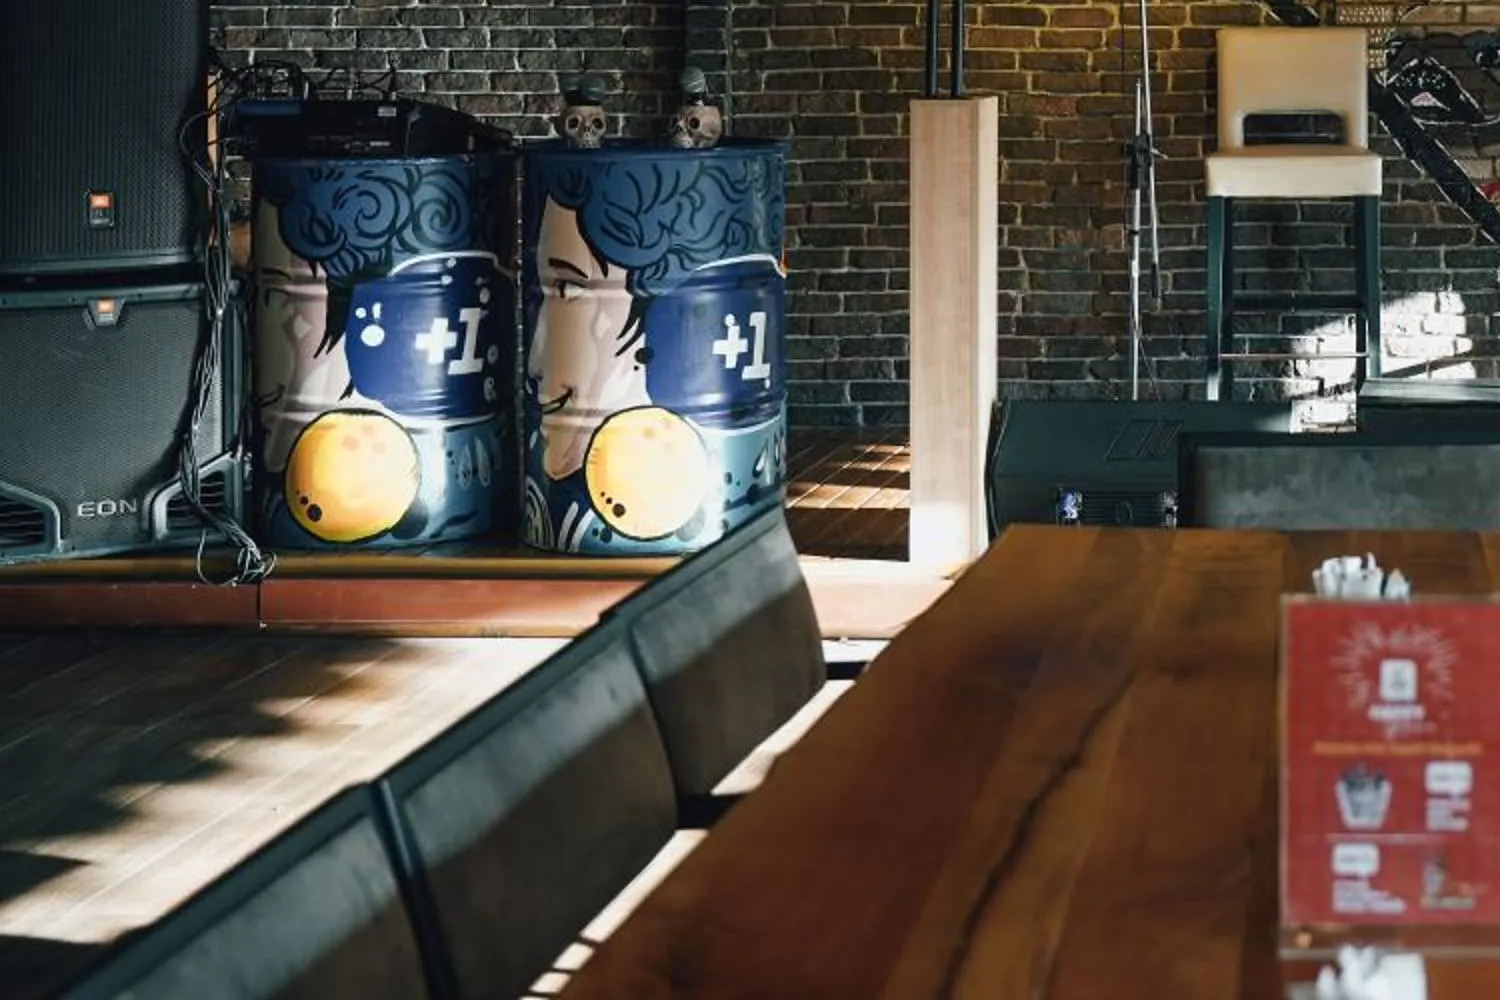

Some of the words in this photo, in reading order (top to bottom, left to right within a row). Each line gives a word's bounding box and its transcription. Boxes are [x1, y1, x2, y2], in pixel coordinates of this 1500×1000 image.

[414, 307, 484, 376] +1
[711, 311, 772, 385] +1
[76, 497, 138, 517] EON
